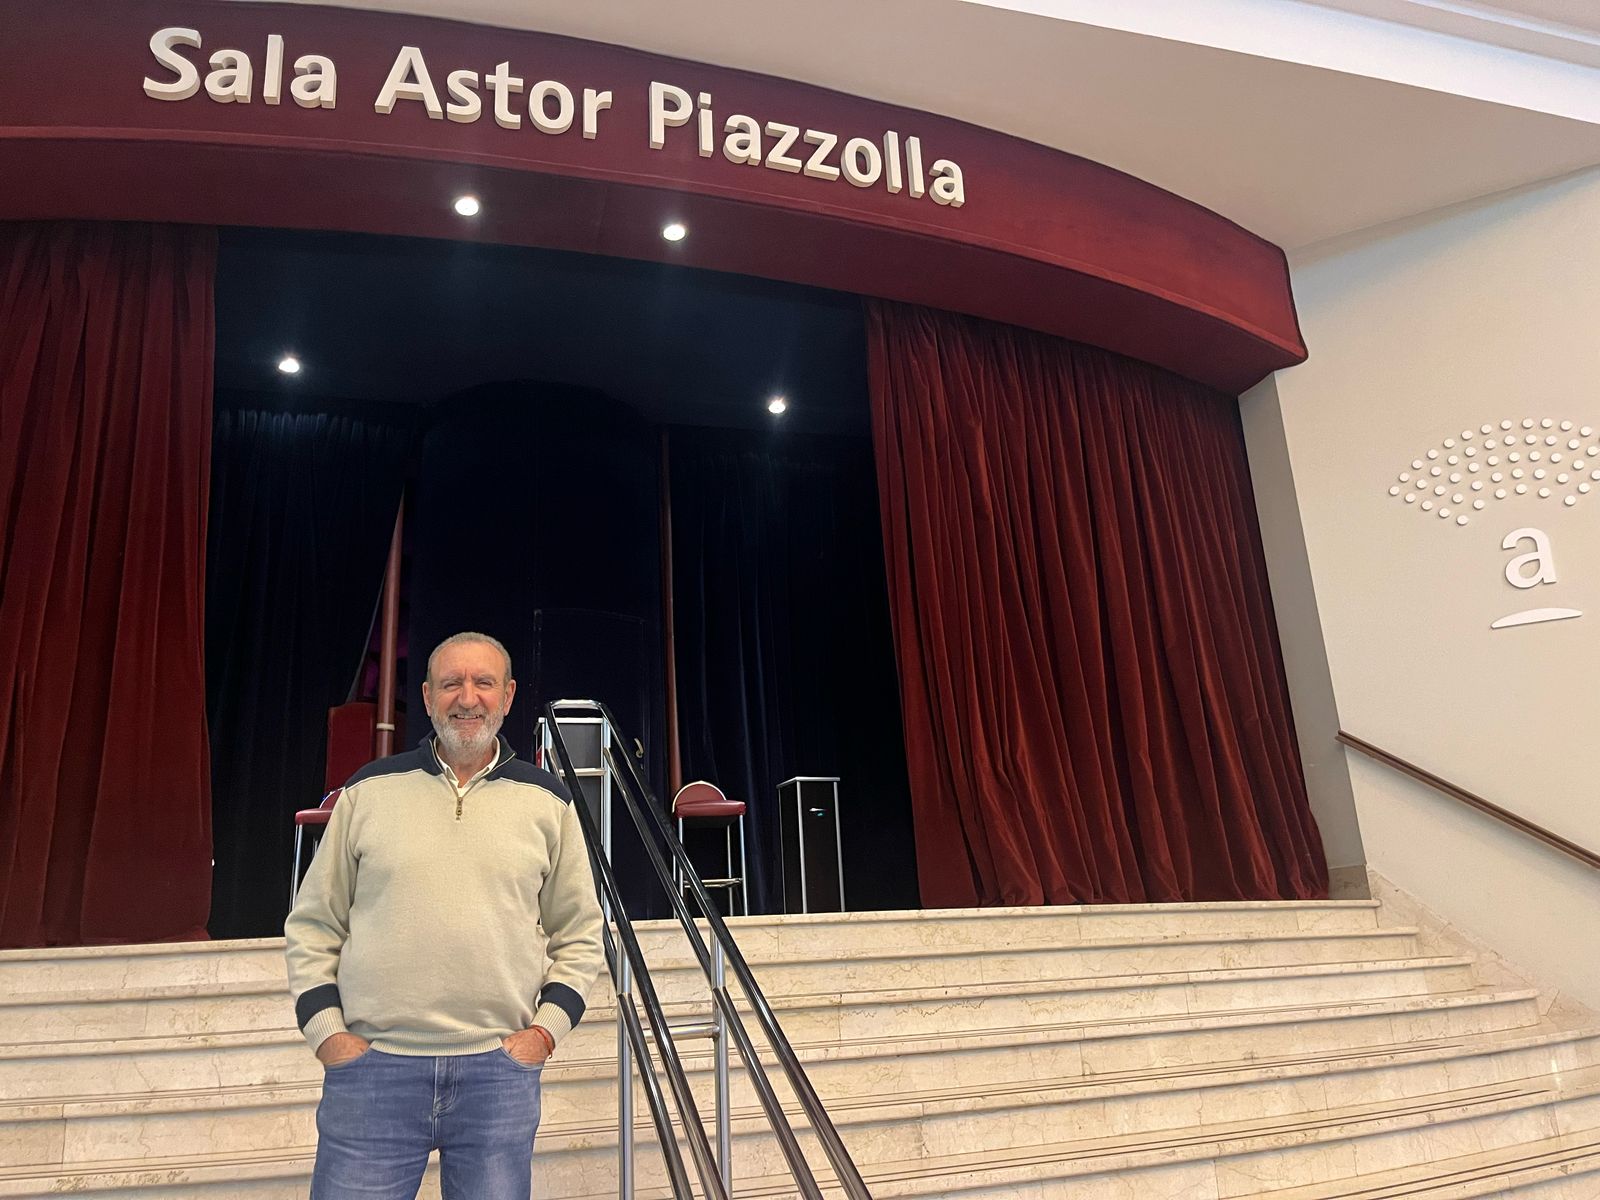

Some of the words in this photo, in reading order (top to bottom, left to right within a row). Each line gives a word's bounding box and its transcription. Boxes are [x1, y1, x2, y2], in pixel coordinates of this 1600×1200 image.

[143, 27, 336, 109] Sala
[374, 46, 612, 140] Astor
[648, 81, 965, 208] Piazzolla
[1502, 527, 1557, 589] a
